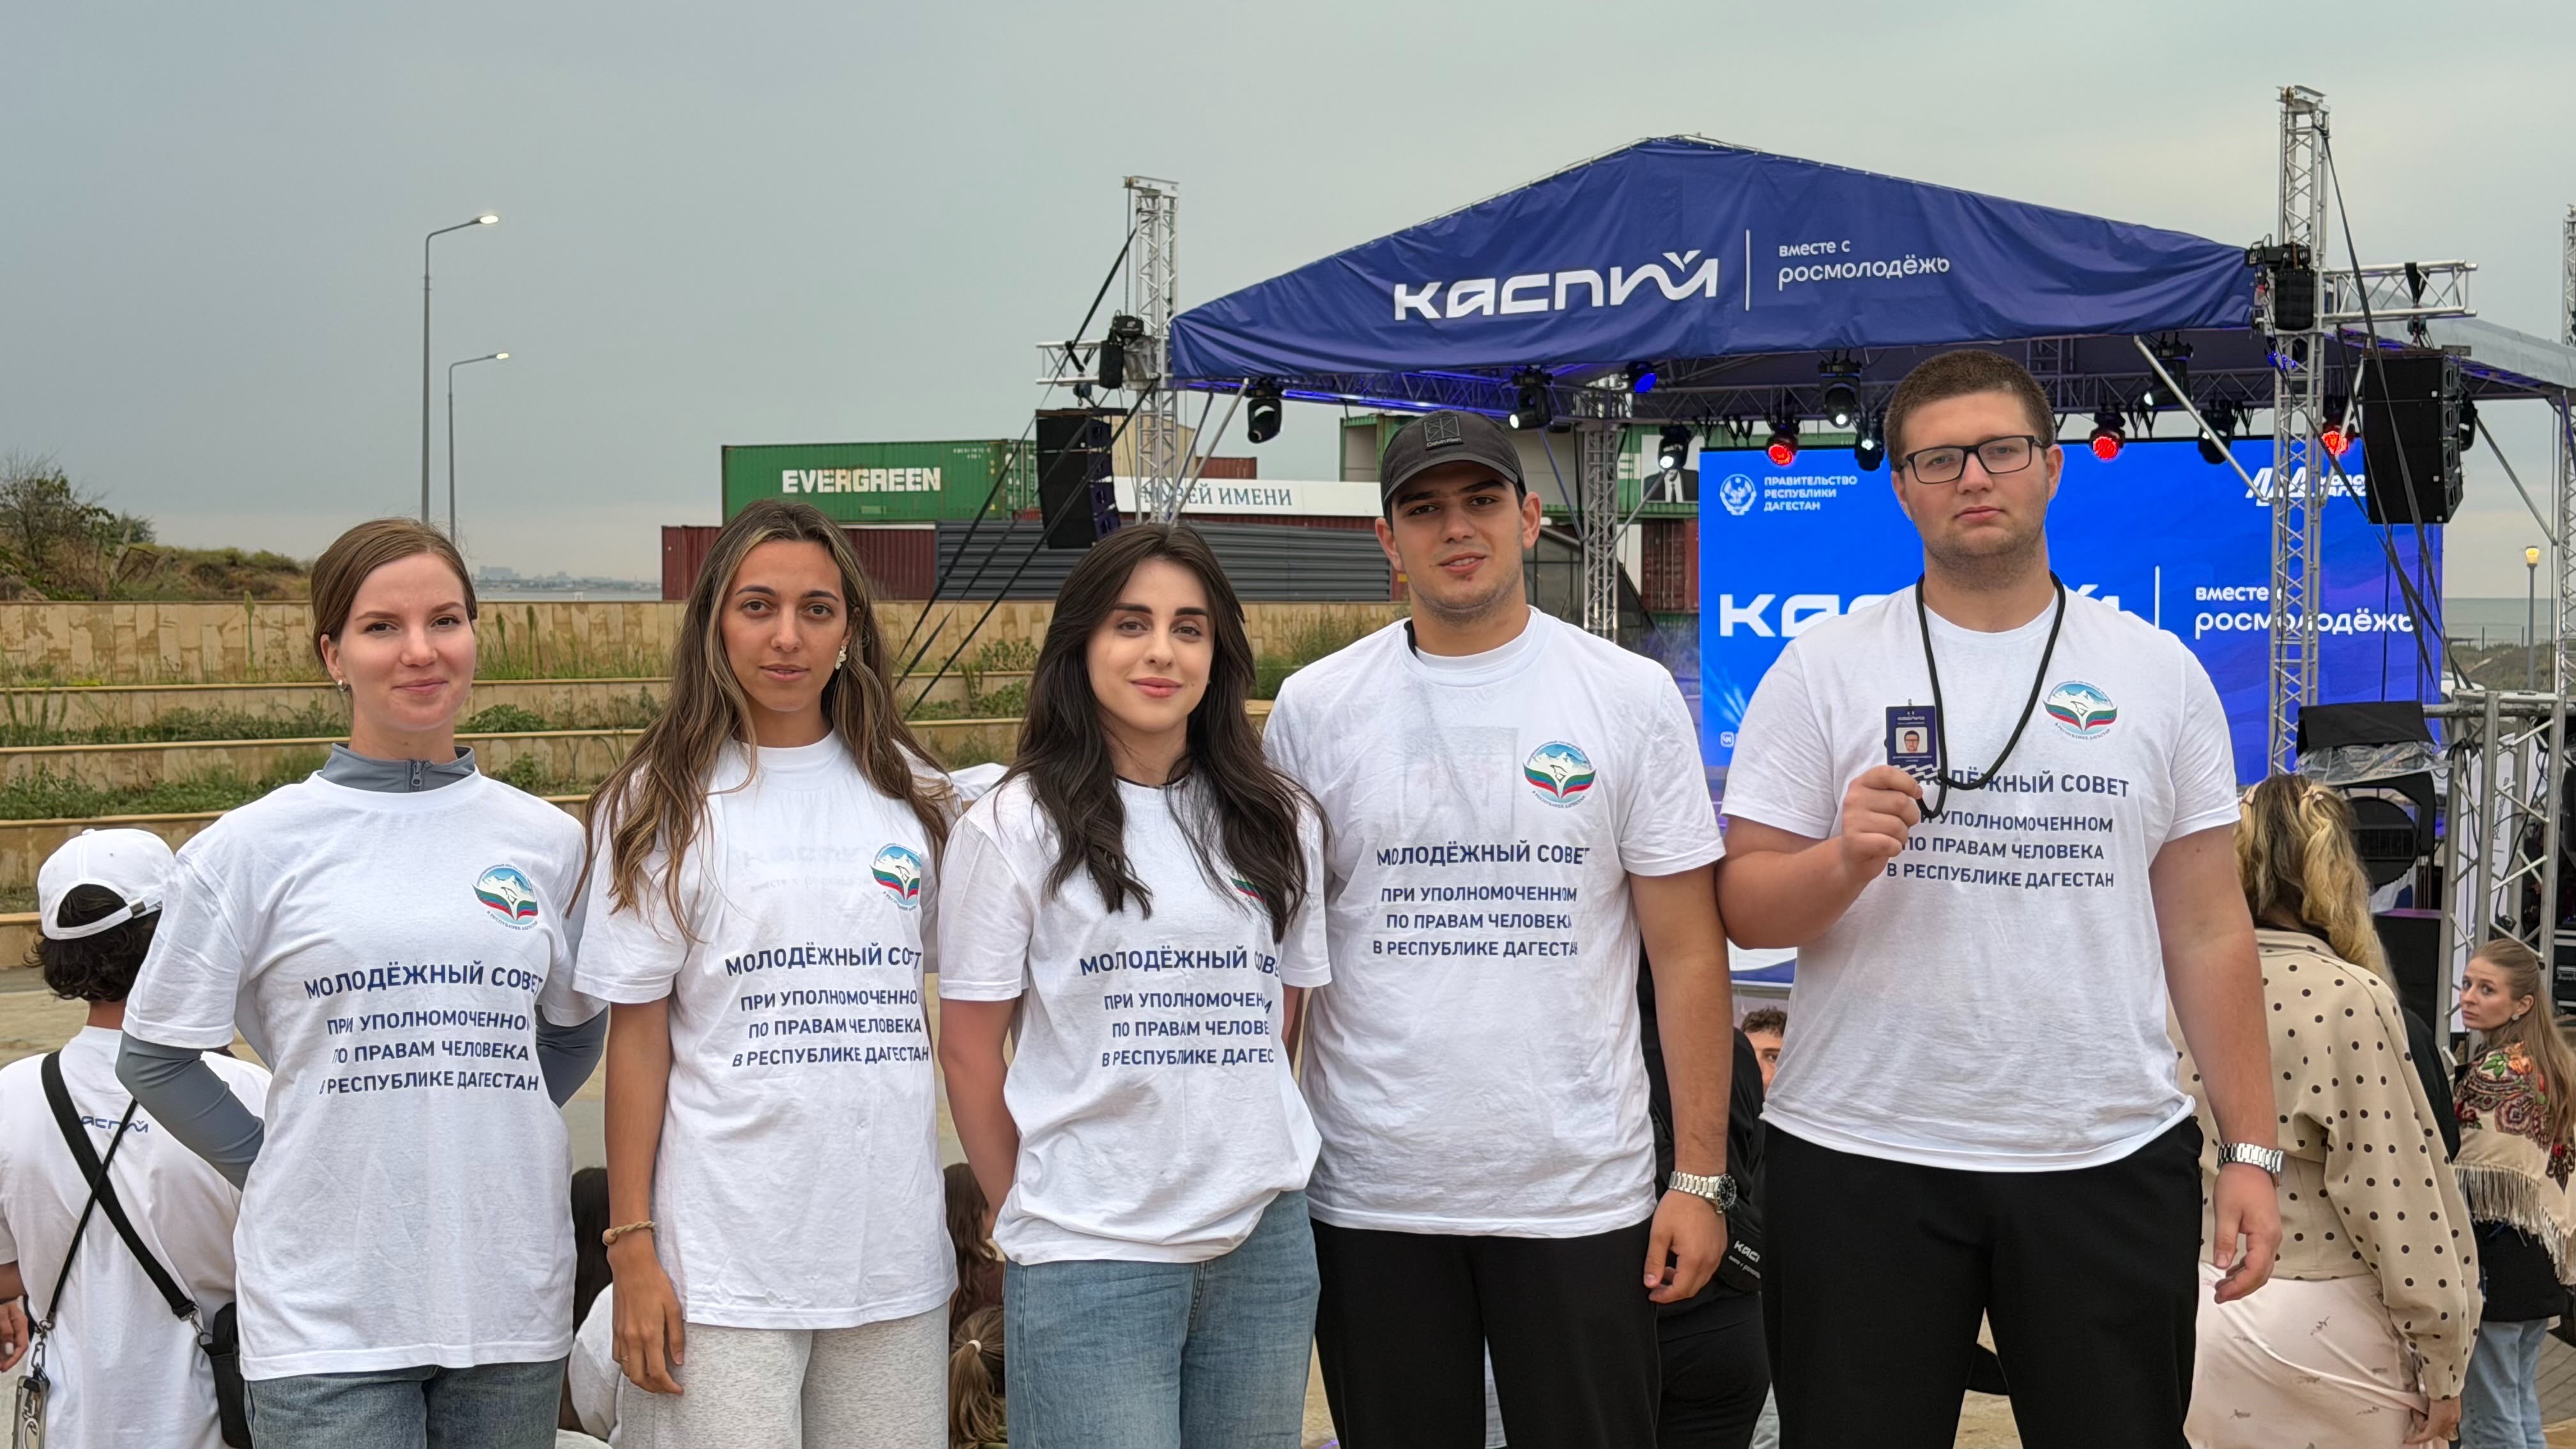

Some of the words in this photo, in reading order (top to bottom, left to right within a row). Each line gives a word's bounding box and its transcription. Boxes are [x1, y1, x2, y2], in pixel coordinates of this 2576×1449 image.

[1779, 241, 1836, 257] вместе
[1841, 240, 1851, 252] с
[1779, 254, 1950, 291] росмолодёжь
[782, 467, 940, 493] EVERGREEN
[1764, 475, 1858, 486] ПРАВИТЕЛЬСТВО
[1218, 488, 1292, 506] ИМЕНИ
[1764, 489, 1837, 498] РЕСПУБЛИКИ
[1764, 501, 1820, 512] ДАГЕСТАН
[2195, 586, 2269, 601] вместе
[1917, 766, 2053, 793] ДЁЖНЫЙ
[2061, 774, 2129, 797] СОВЕТ
[1940, 810, 2113, 832] УПОЛНОМОЧЕННОМ
[1377, 839, 1529, 866] МОЛОДЁЖНЫЙ
[1933, 838, 2006, 858] ПРАВАМ
[2011, 844, 2104, 859] ЧЕЛОВЕКА
[1887, 862, 1897, 877] В
[1904, 863, 2022, 887] РЕСПУБЛИКЕ
[2025, 872, 2113, 889] ДАГЕСТАН
[1381, 888, 1414, 901] ПРИ
[1420, 886, 1577, 901] УПОЛНОМОЧЕННОМ
[1386, 914, 1409, 928] ПО
[1414, 914, 1483, 928] ПРАВАМ
[1373, 940, 1382, 954] В
[1387, 941, 1498, 956] РЕСПУБЛИКЕ
[725, 942, 882, 977] МОЛОДЁЖНЫЙ
[1079, 945, 1247, 976] МОЛОДЁЖНЫЙ
[304, 960, 484, 999] МОЛОДЁЖНЫЙ
[491, 967, 544, 996] СОВЕТ
[741, 993, 775, 1011] ПРИ
[780, 989, 917, 1006] УПОЛНОМОЧЕННО
[1104, 993, 1133, 1010] ПРИ
[326, 1017, 354, 1035] ПРИ
[359, 1009, 531, 1031] УПОЛНОМОЧЕННО
[749, 1022, 769, 1039] ПО
[774, 1018, 847, 1035] ПРАВАМ
[850, 1018, 922, 1033] ЧЕЛОВЕКА
[1112, 1022, 1130, 1038] ПО
[1135, 1022, 1200, 1037] ПРАВАМ
[1205, 1020, 1269, 1036] ЧЕЛОВЕ
[355, 1041, 434, 1062] ПРАВАМ
[442, 1040, 529, 1061] ЧЕЛОВЕКА
[732, 1054, 742, 1067] В
[746, 1046, 862, 1066] РЕСПУБЛИКЕ
[864, 1046, 929, 1064] ДАГЕСТАН
[1102, 1052, 1110, 1066] В
[1112, 1049, 1216, 1066] РЕСПУБЛИКЕ
[327, 1071, 454, 1094] РЕСПУБЛИКЕ
[456, 1071, 539, 1091] ДАГЕСТАН
